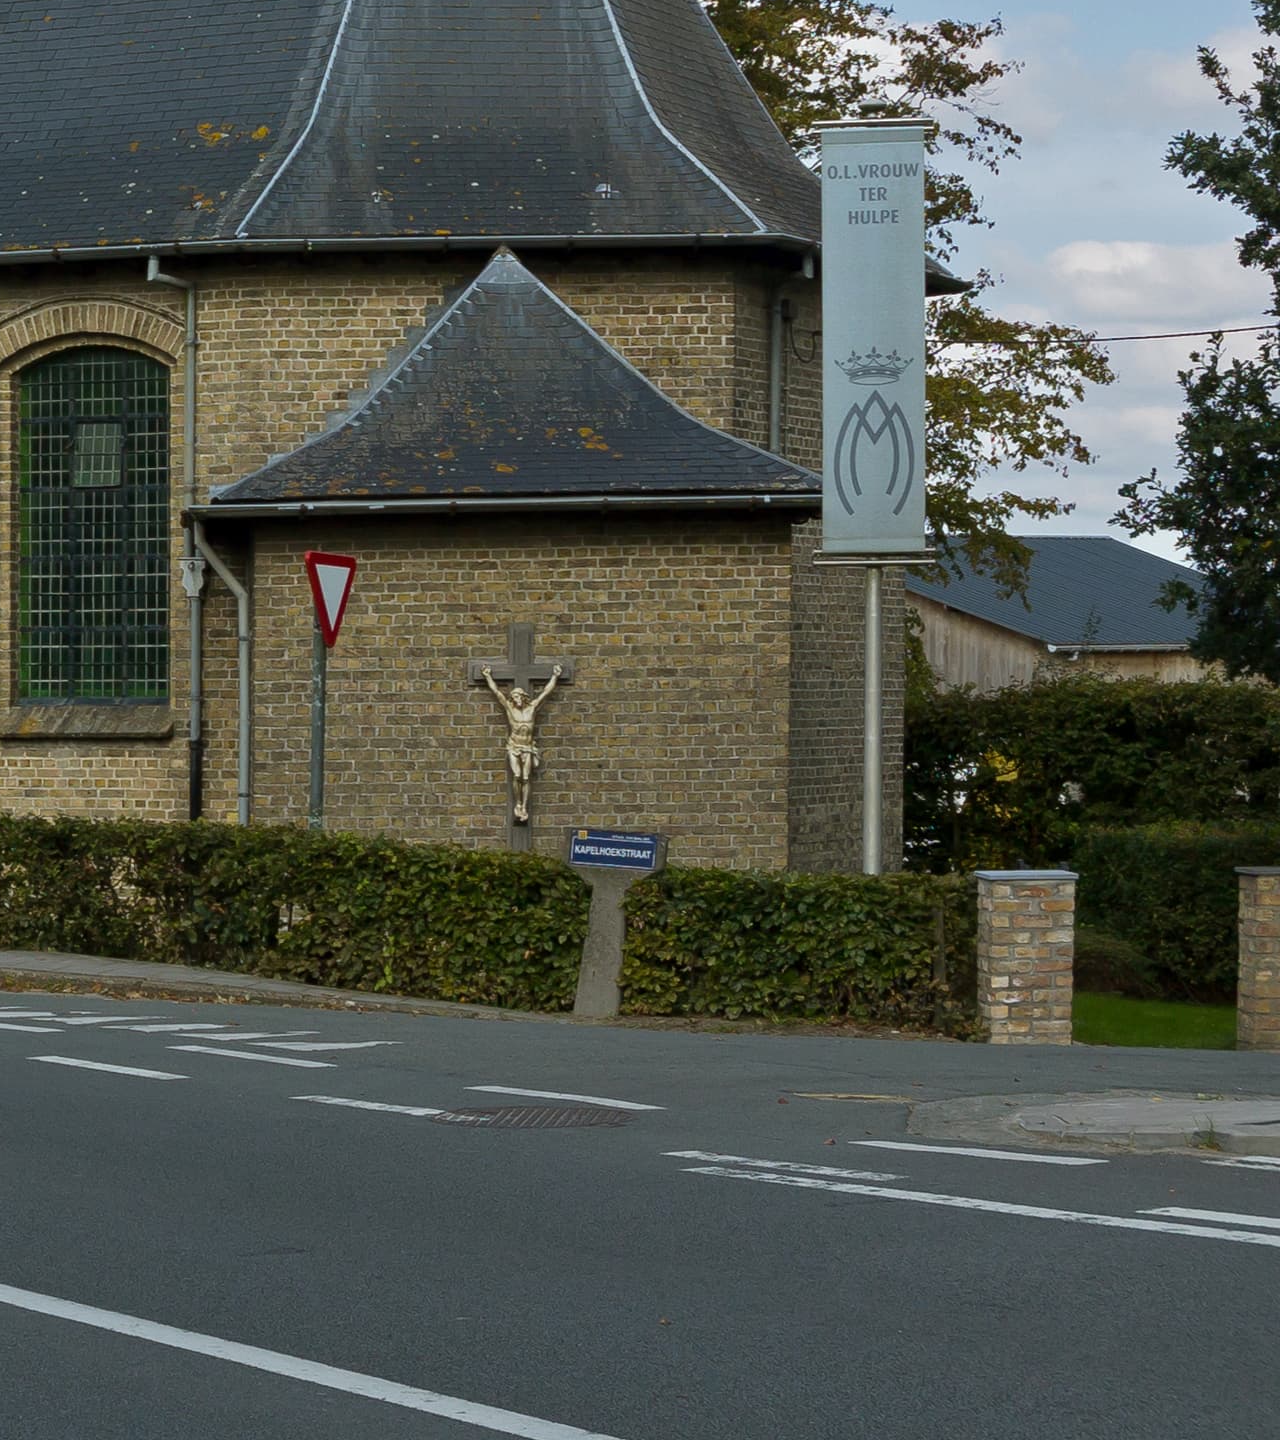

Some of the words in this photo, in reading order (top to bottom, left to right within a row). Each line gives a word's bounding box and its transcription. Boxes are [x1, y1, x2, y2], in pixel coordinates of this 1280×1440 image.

[859, 186, 888, 201] TER
[848, 209, 899, 224] HULPE
[574, 844, 652, 859] KAPELHOEKSTRAAT
